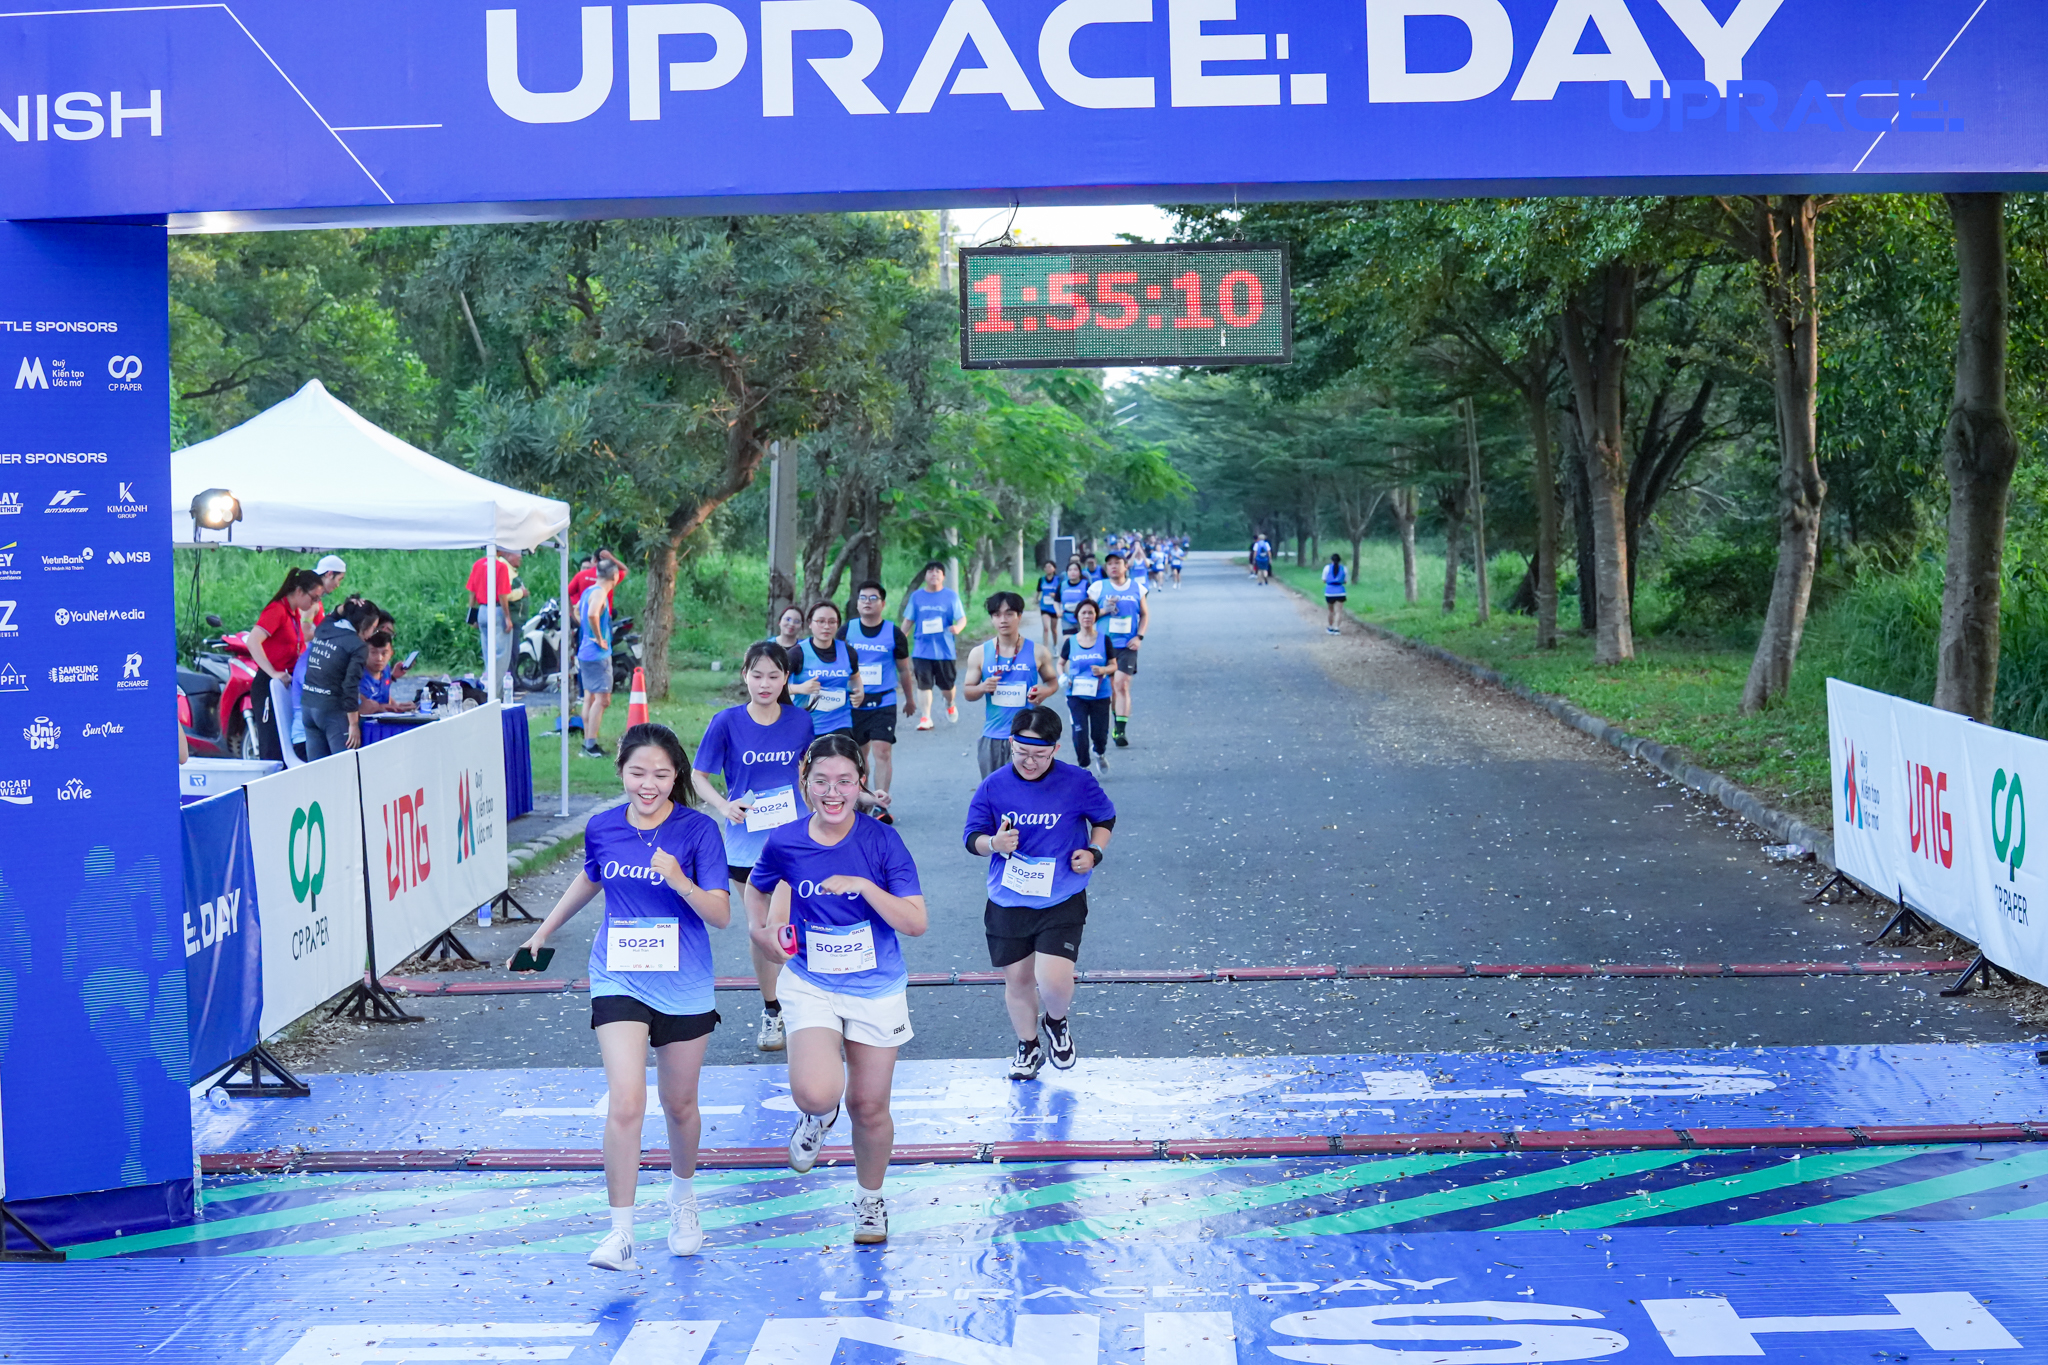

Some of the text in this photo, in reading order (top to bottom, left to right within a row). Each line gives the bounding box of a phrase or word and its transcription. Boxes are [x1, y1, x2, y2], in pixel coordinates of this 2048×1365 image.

[1366, 0, 1786, 104] DAY
[971, 270, 1265, 334] 1:55:10
[35, 321, 118, 333] SPONSORS
[71, 369, 84, 379] tạo
[108, 383, 143, 391] CP PAPER
[25, 452, 108, 464] SPONSORS
[107, 504, 148, 513] KIM OANH
[126, 551, 151, 563] MSB
[58, 665, 99, 674] SAMSUNG
[58, 673, 99, 683] Best Clinic
[117, 680, 149, 688] RECHARGE
[30, 721, 54, 737] Uni
[30, 737, 55, 750] Dry
[742, 750, 796, 766] Ocany
[753, 801, 789, 815] 50224
[1011, 865, 1045, 880] 50225
[2003, 888, 2029, 927] PAPER
[199, 887, 241, 949] DAY
[292, 915, 330, 961] CP PAPER
[618, 938, 665, 948] 50221
[815, 942, 864, 954] 50222
[1232, 1276, 1459, 1296] DAY
